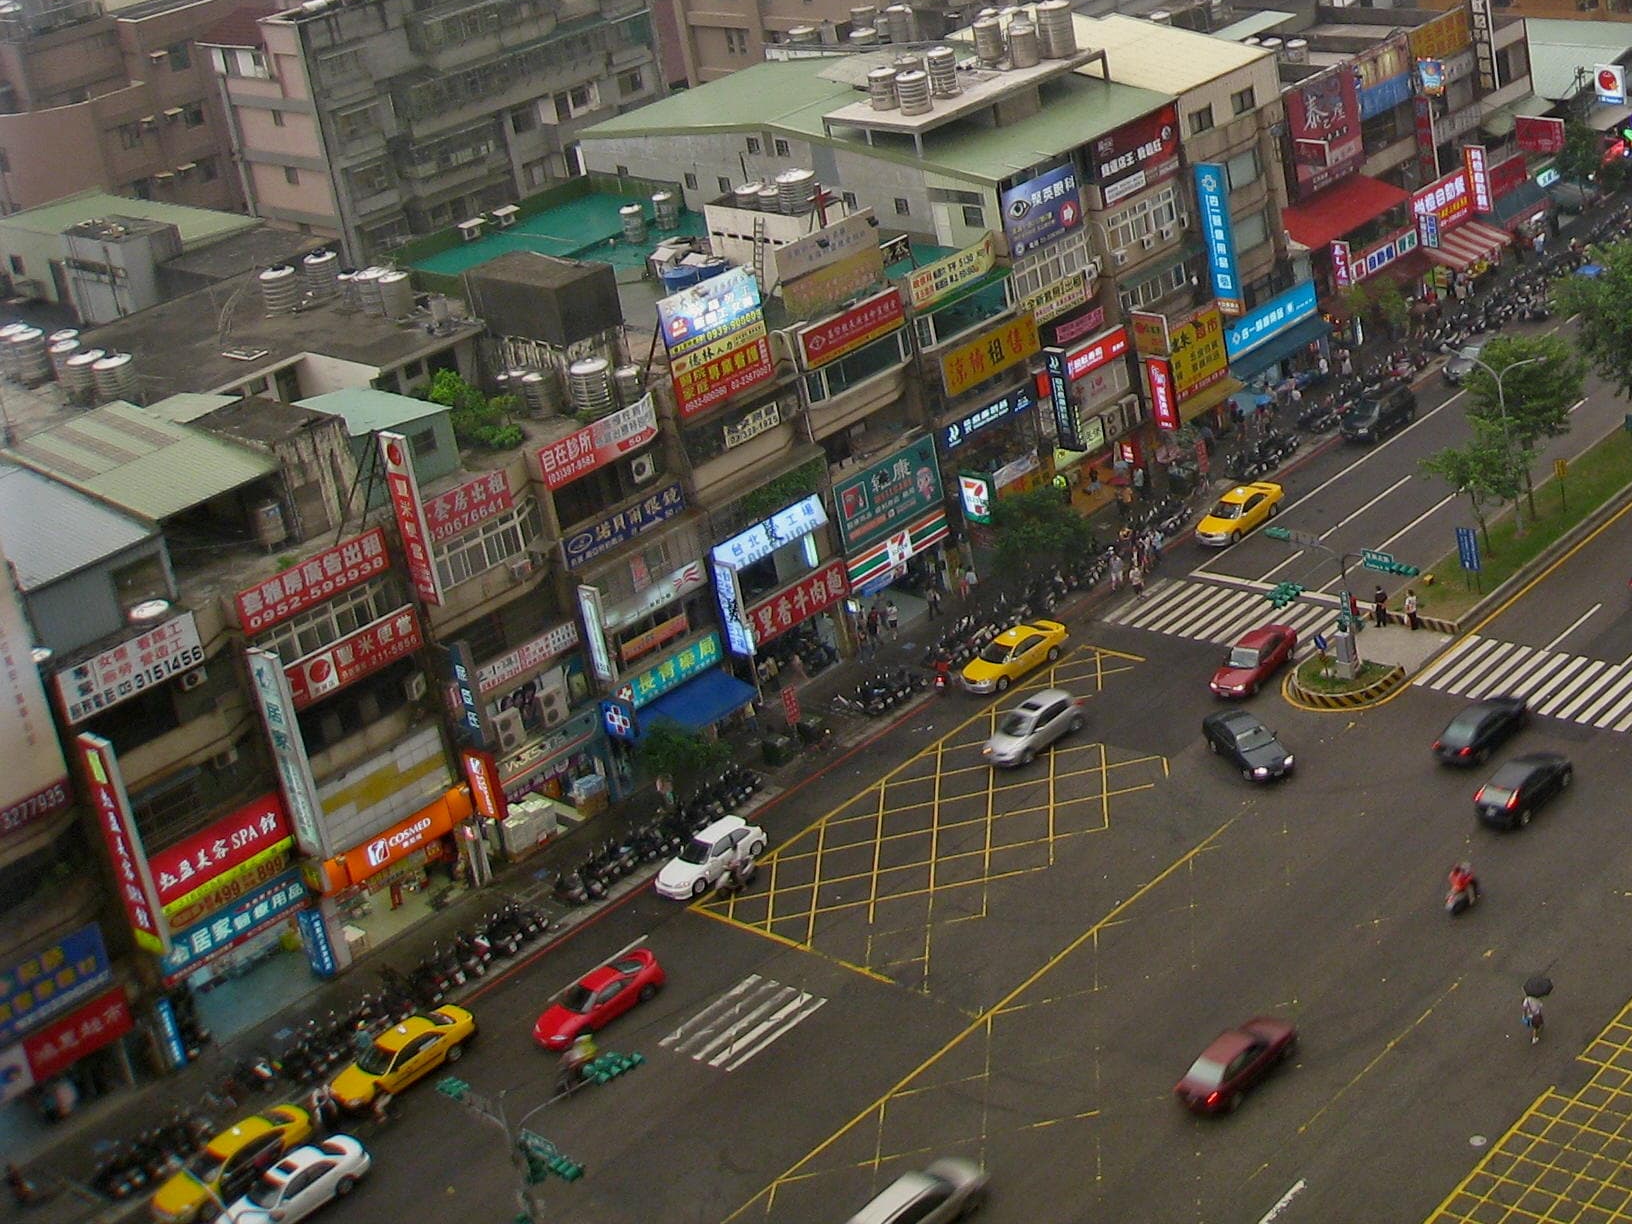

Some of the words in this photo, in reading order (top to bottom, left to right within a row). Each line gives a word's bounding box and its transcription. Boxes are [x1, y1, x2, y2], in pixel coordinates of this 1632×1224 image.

[541, 428, 594, 474] 自在診所
[433, 471, 510, 523] 套房出租
[135, 644, 203, 689] 3151456
[388, 816, 432, 849] COSMED
